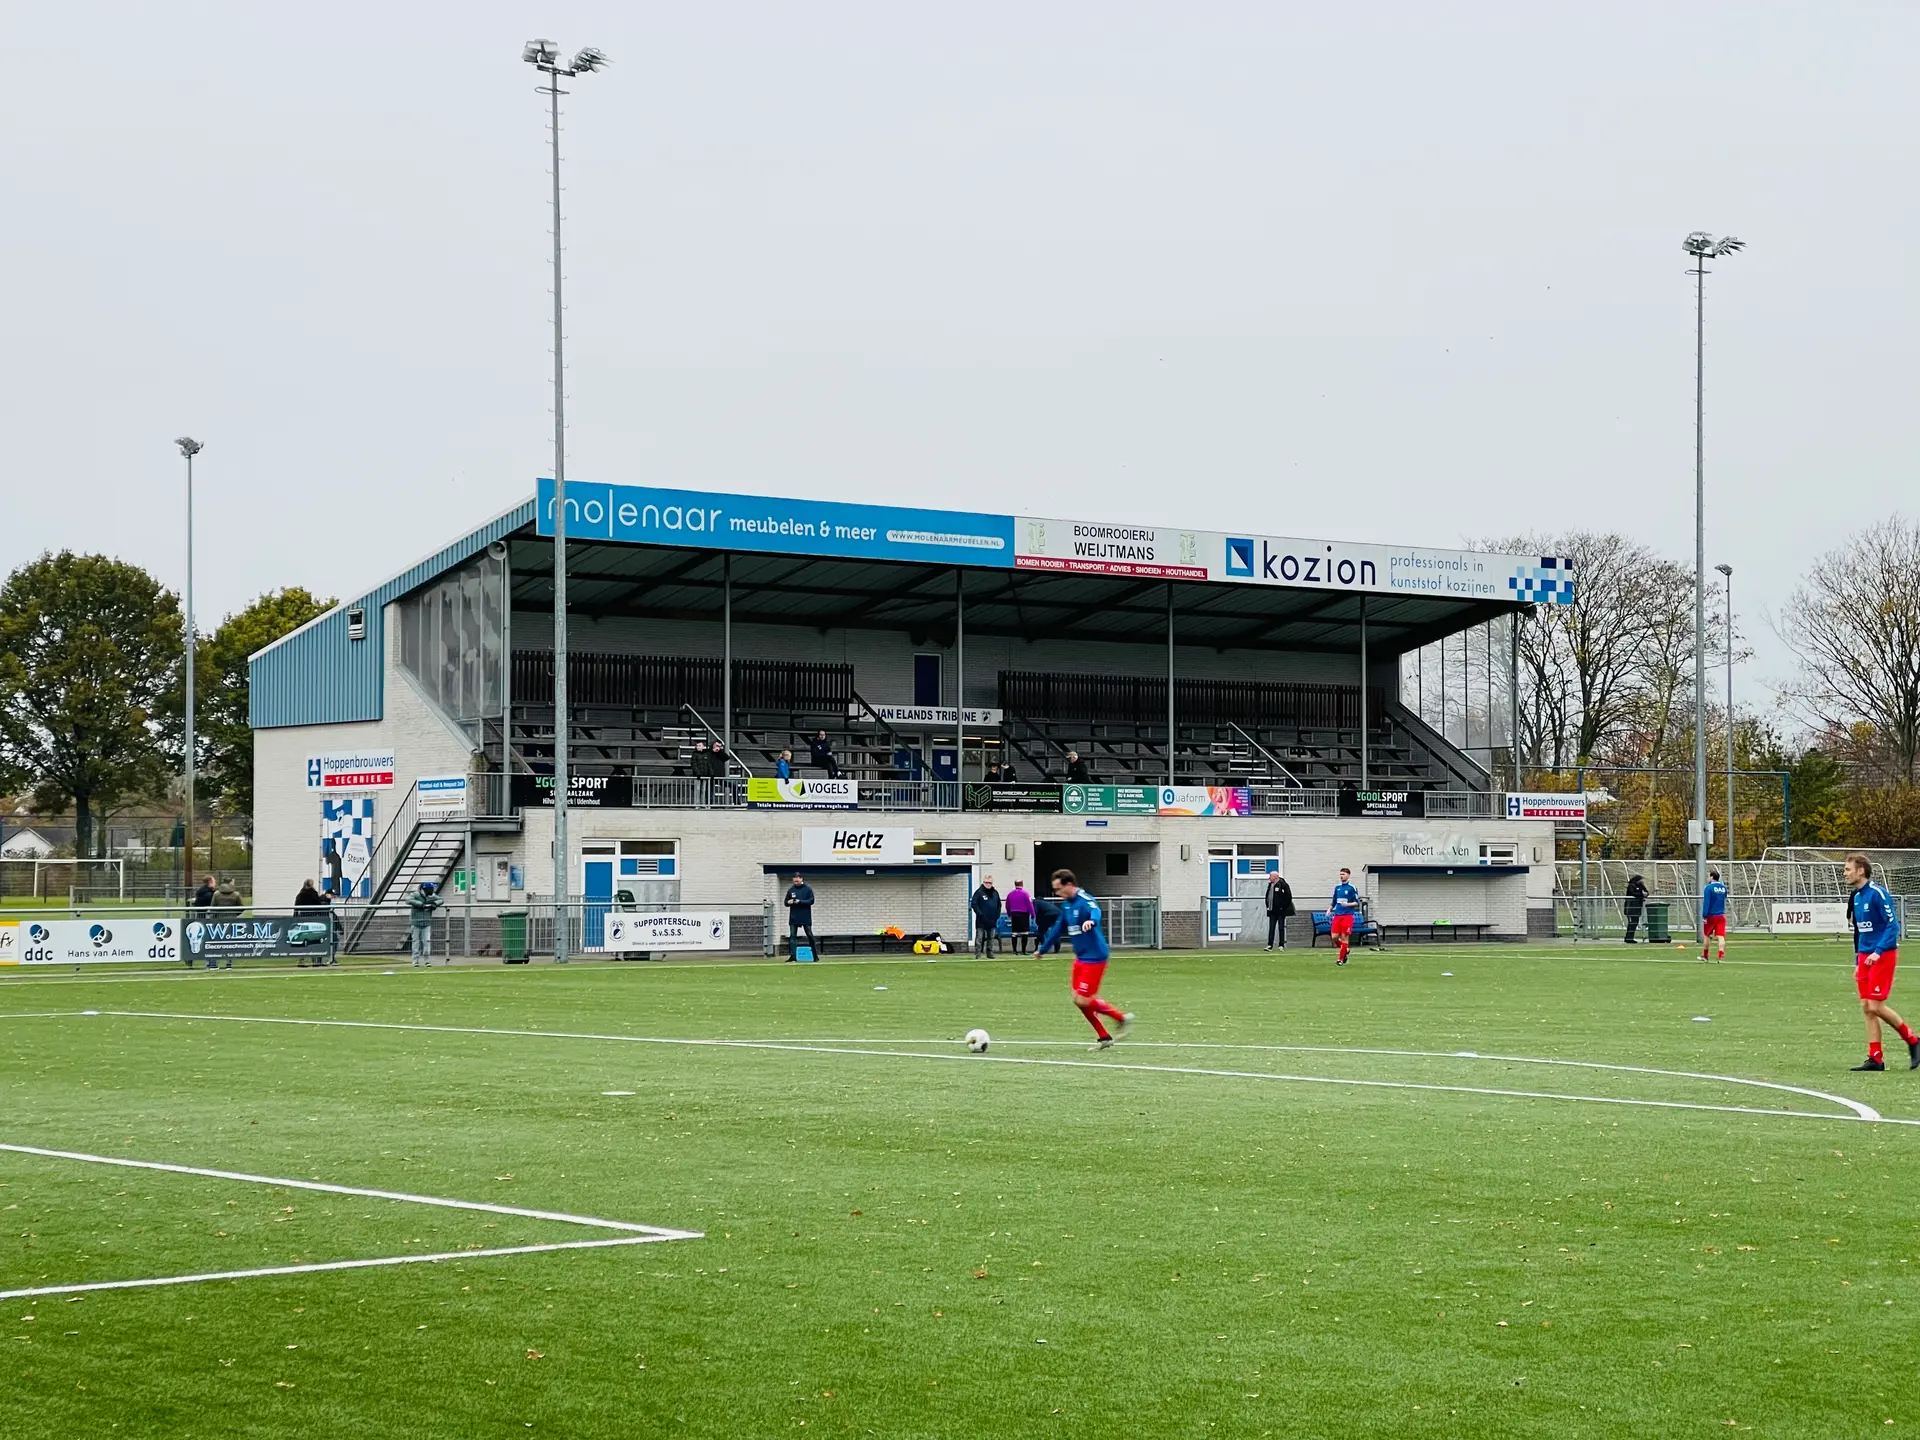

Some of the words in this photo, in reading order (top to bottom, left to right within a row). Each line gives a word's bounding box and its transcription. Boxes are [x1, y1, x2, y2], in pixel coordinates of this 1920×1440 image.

[548, 489, 722, 537] molenaar
[729, 516, 816, 537] meubelen
[820, 524, 830, 538] &
[835, 525, 877, 541] meer
[1073, 525, 1155, 542] BOOMROOIERIJ
[1074, 542, 1155, 560] WEIJTMANS
[1016, 558, 1040, 567] BOMEN
[1041, 560, 1065, 569] ROOIEN
[1069, 561, 1105, 571] TRANSPORT
[1109, 564, 1131, 573] ADVIES
[1135, 566, 1162, 575] SNOEIEN
[1165, 568, 1205, 578] HOUTHANDEL
[1263, 540, 1376, 586] kozion
[1390, 552, 1468, 573] professionals
[1473, 559, 1484, 572] in
[1390, 575, 1442, 591] kunststof
[1447, 578, 1496, 597] kozijnen
[896, 709, 933, 720] ELANDS
[324, 755, 394, 772] Hoppenbrouwers
[335, 775, 382, 785] TECHNIEK
[808, 783, 849, 794] VOGELS
[1522, 796, 1585, 807] Hoppenbrouwers
[832, 830, 884, 849] Hertz
[1402, 844, 1434, 856] Robert
[633, 917, 702, 928] SUPPORTERSCLUB
[1776, 911, 1811, 924] ANPE
[205, 922, 277, 939] W.E.M.
[24, 947, 53, 961] ddc
[112, 949, 134, 957] Alem
[148, 944, 176, 959] ddc
